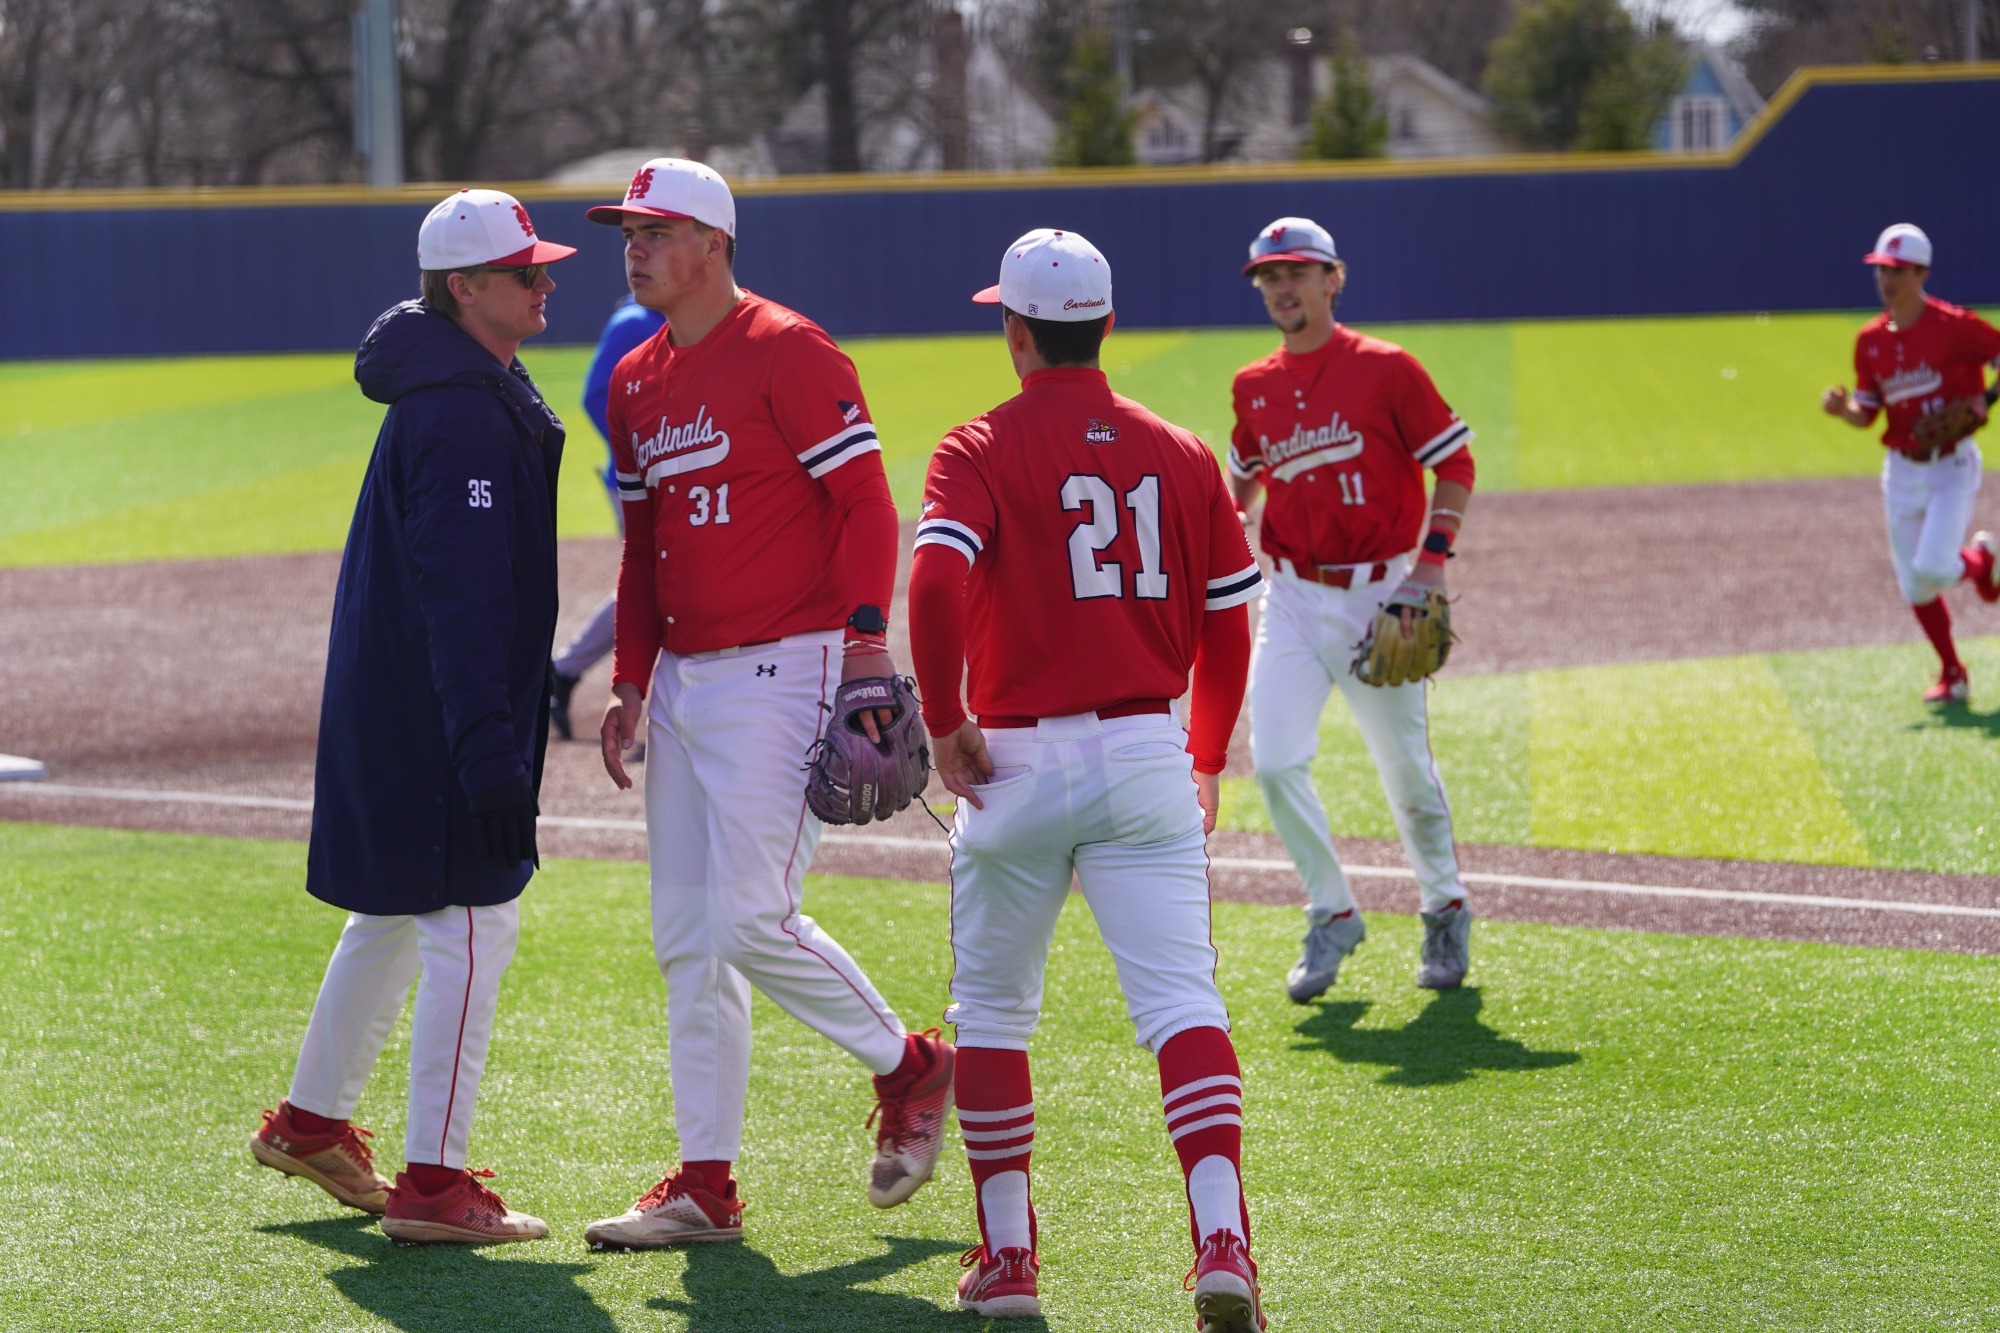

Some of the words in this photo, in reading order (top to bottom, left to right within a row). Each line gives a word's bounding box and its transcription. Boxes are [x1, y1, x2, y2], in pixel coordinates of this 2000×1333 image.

[1063, 297, 1105, 310] Cardinals
[632, 404, 716, 474] Cardinals
[1260, 411, 1352, 469] Cardinals
[468, 478, 492, 508] 35
[688, 482, 731, 527] 31
[1338, 472, 1366, 505] 11
[1060, 473, 1169, 600] 21
[843, 685, 887, 702] Wilson
[861, 783, 872, 812] A2000
